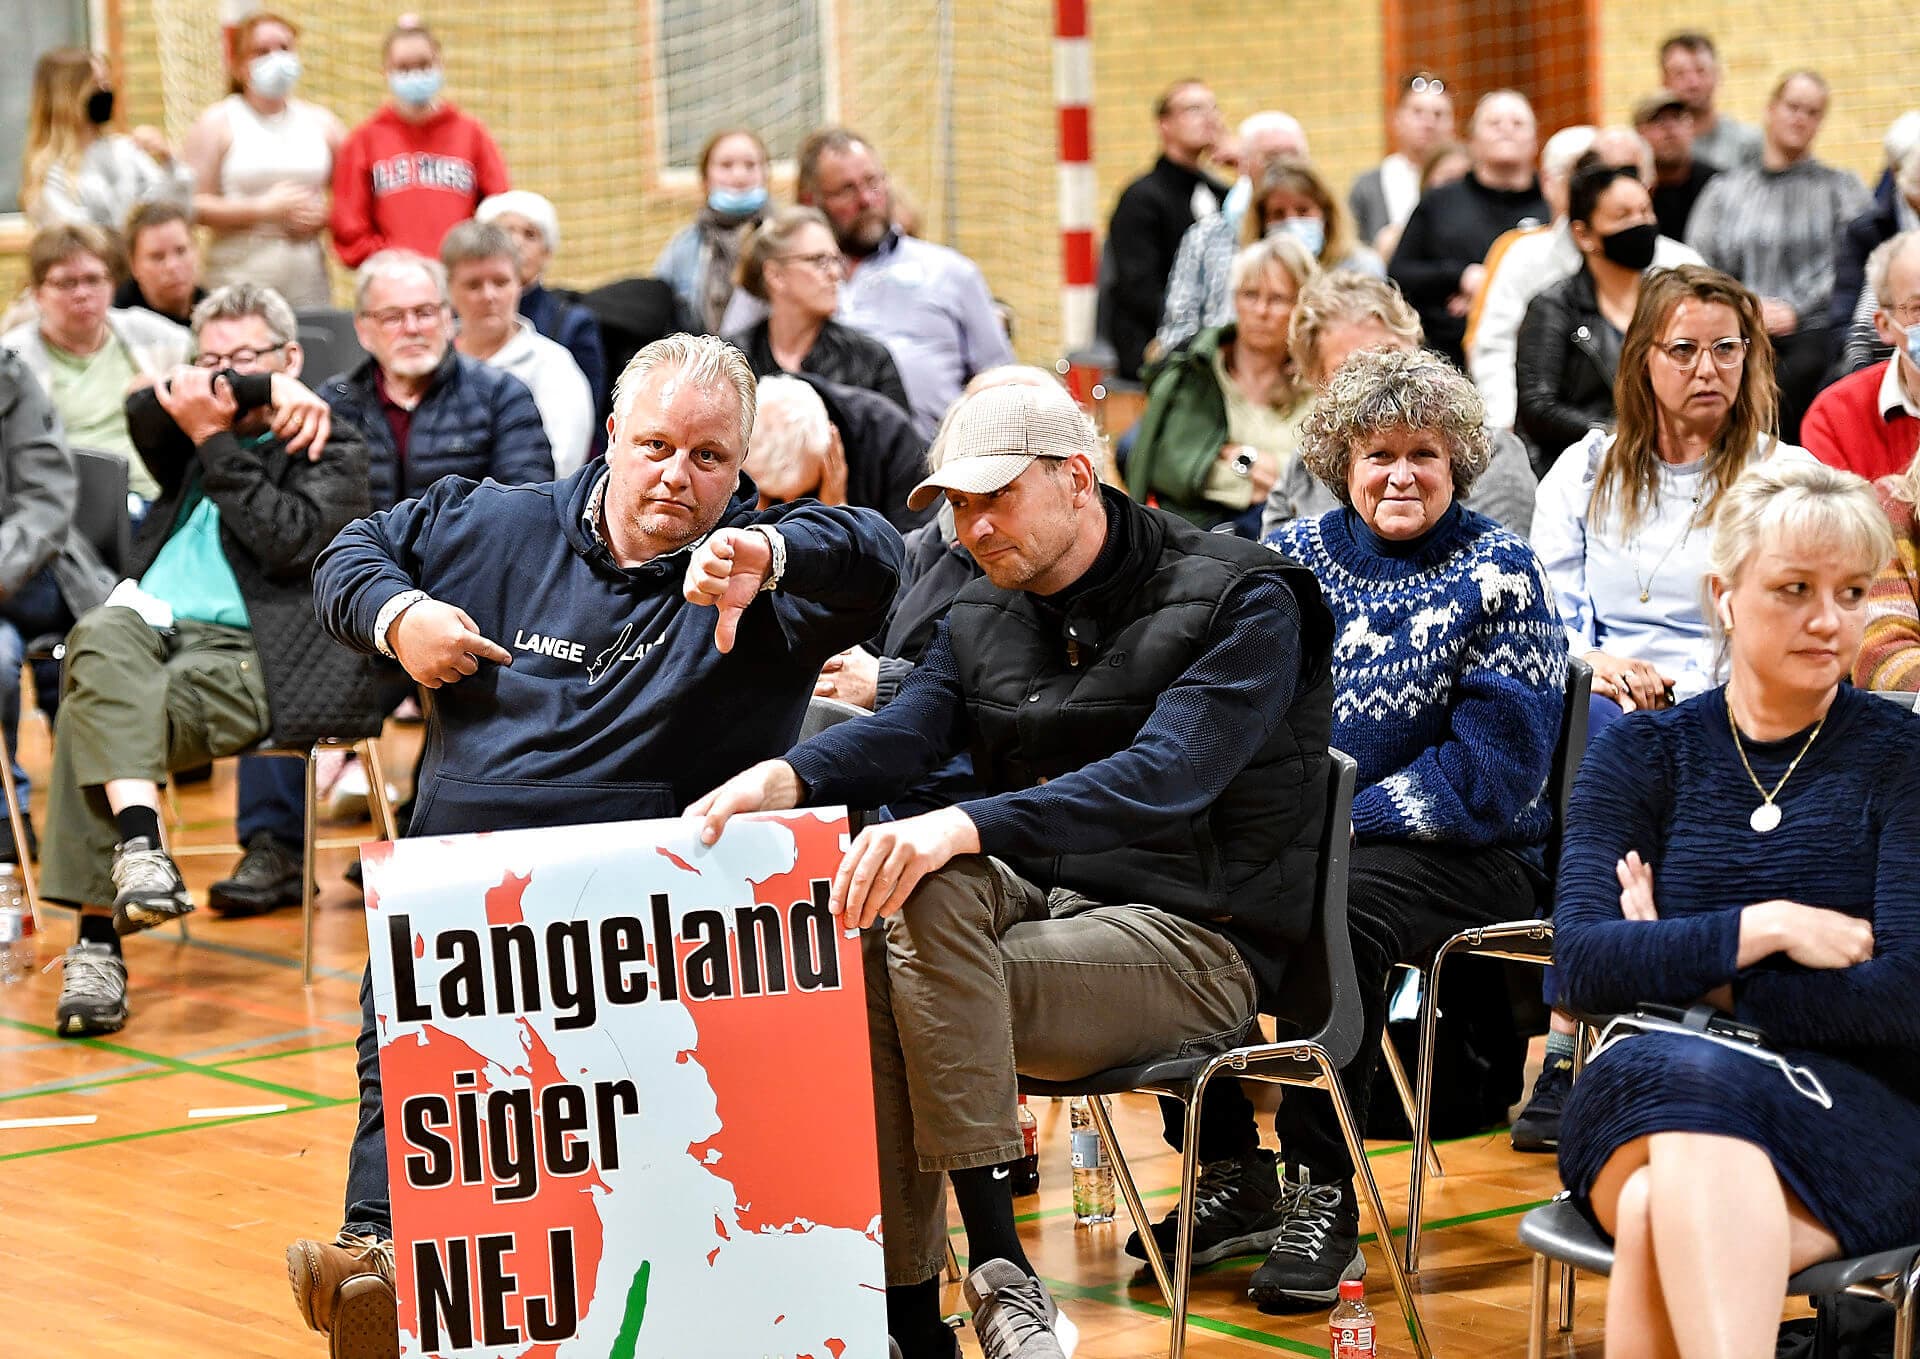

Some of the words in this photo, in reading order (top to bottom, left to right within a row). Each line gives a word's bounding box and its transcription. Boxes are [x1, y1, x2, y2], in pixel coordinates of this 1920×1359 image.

[514, 630, 586, 663] LANGE
[389, 880, 841, 1031] Langeland
[403, 1069, 640, 1202] siger
[411, 1228, 578, 1354] NEJ
